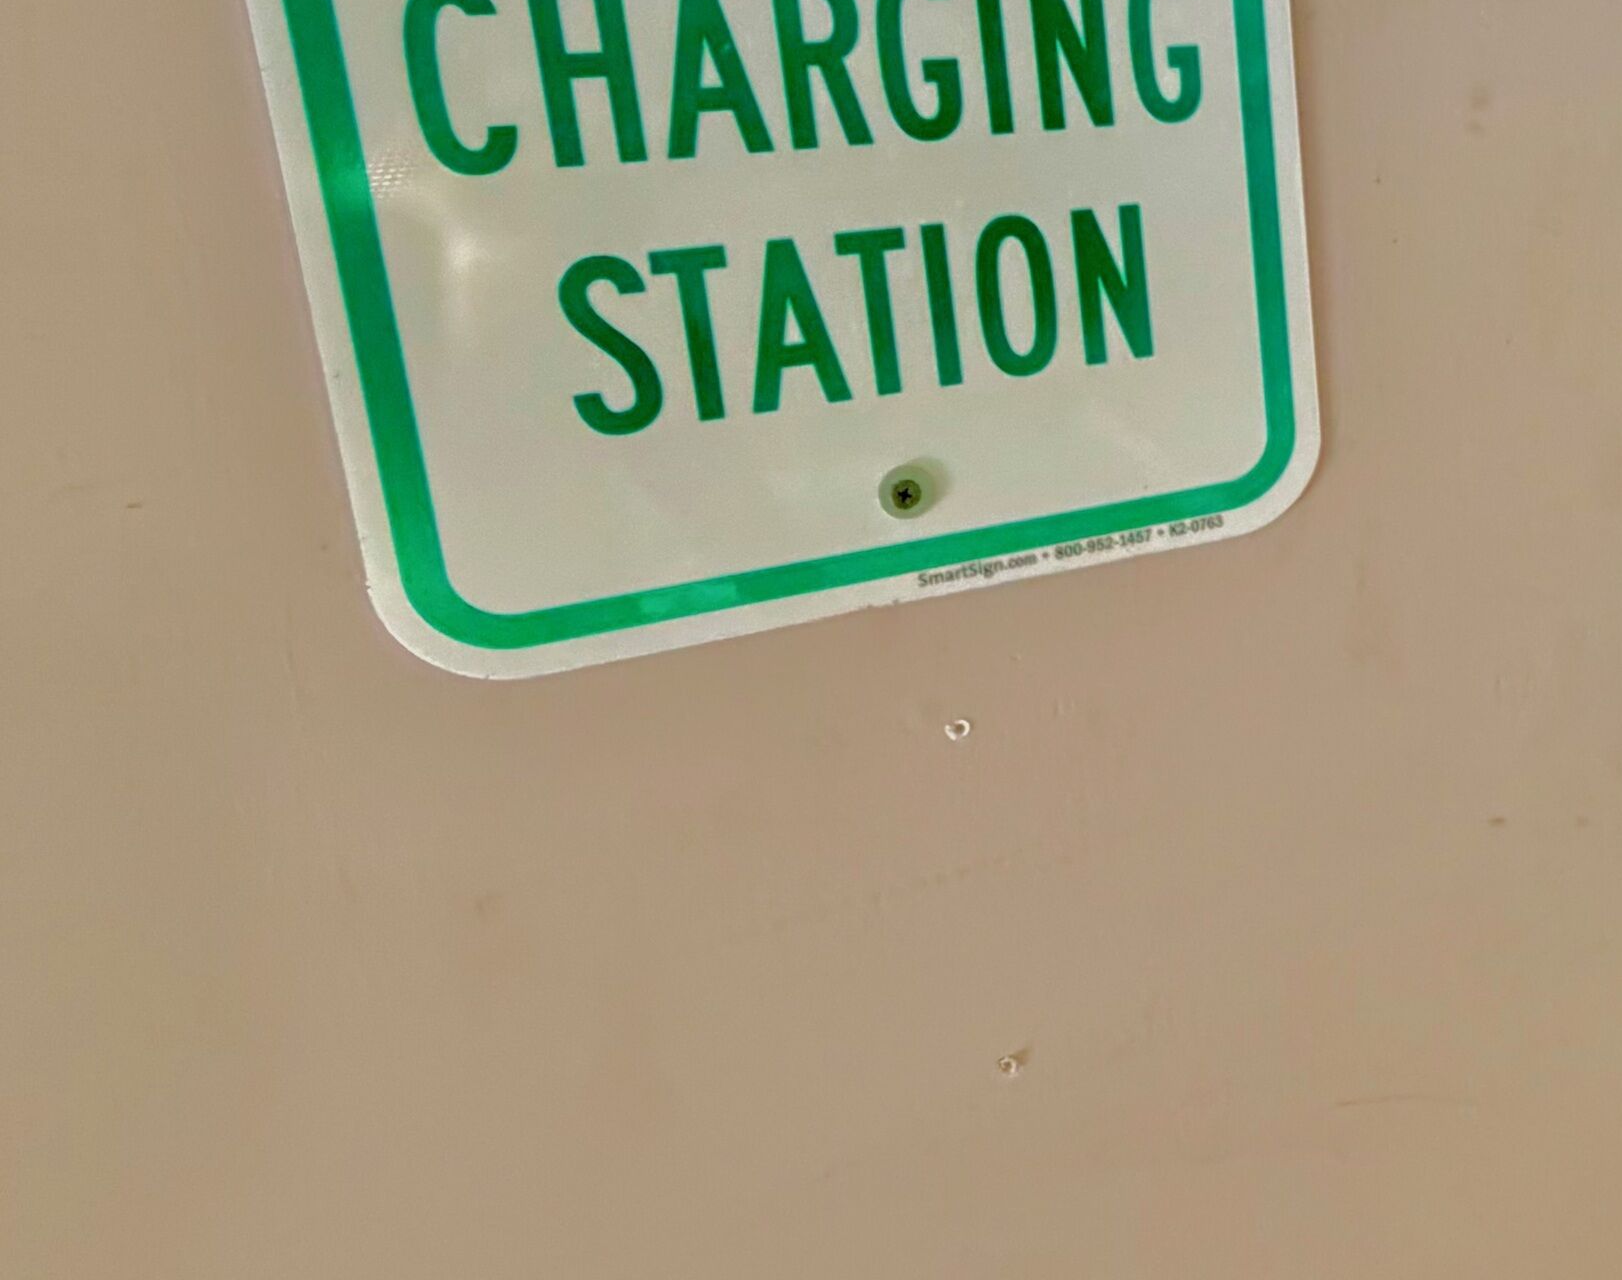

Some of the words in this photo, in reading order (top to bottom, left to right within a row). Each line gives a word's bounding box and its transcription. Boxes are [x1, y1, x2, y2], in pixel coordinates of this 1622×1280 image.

[558, 203, 1154, 436] STATION
[917, 554, 1038, 588] SmartSign.com
[1054, 528, 1152, 560] 800-952-1457
